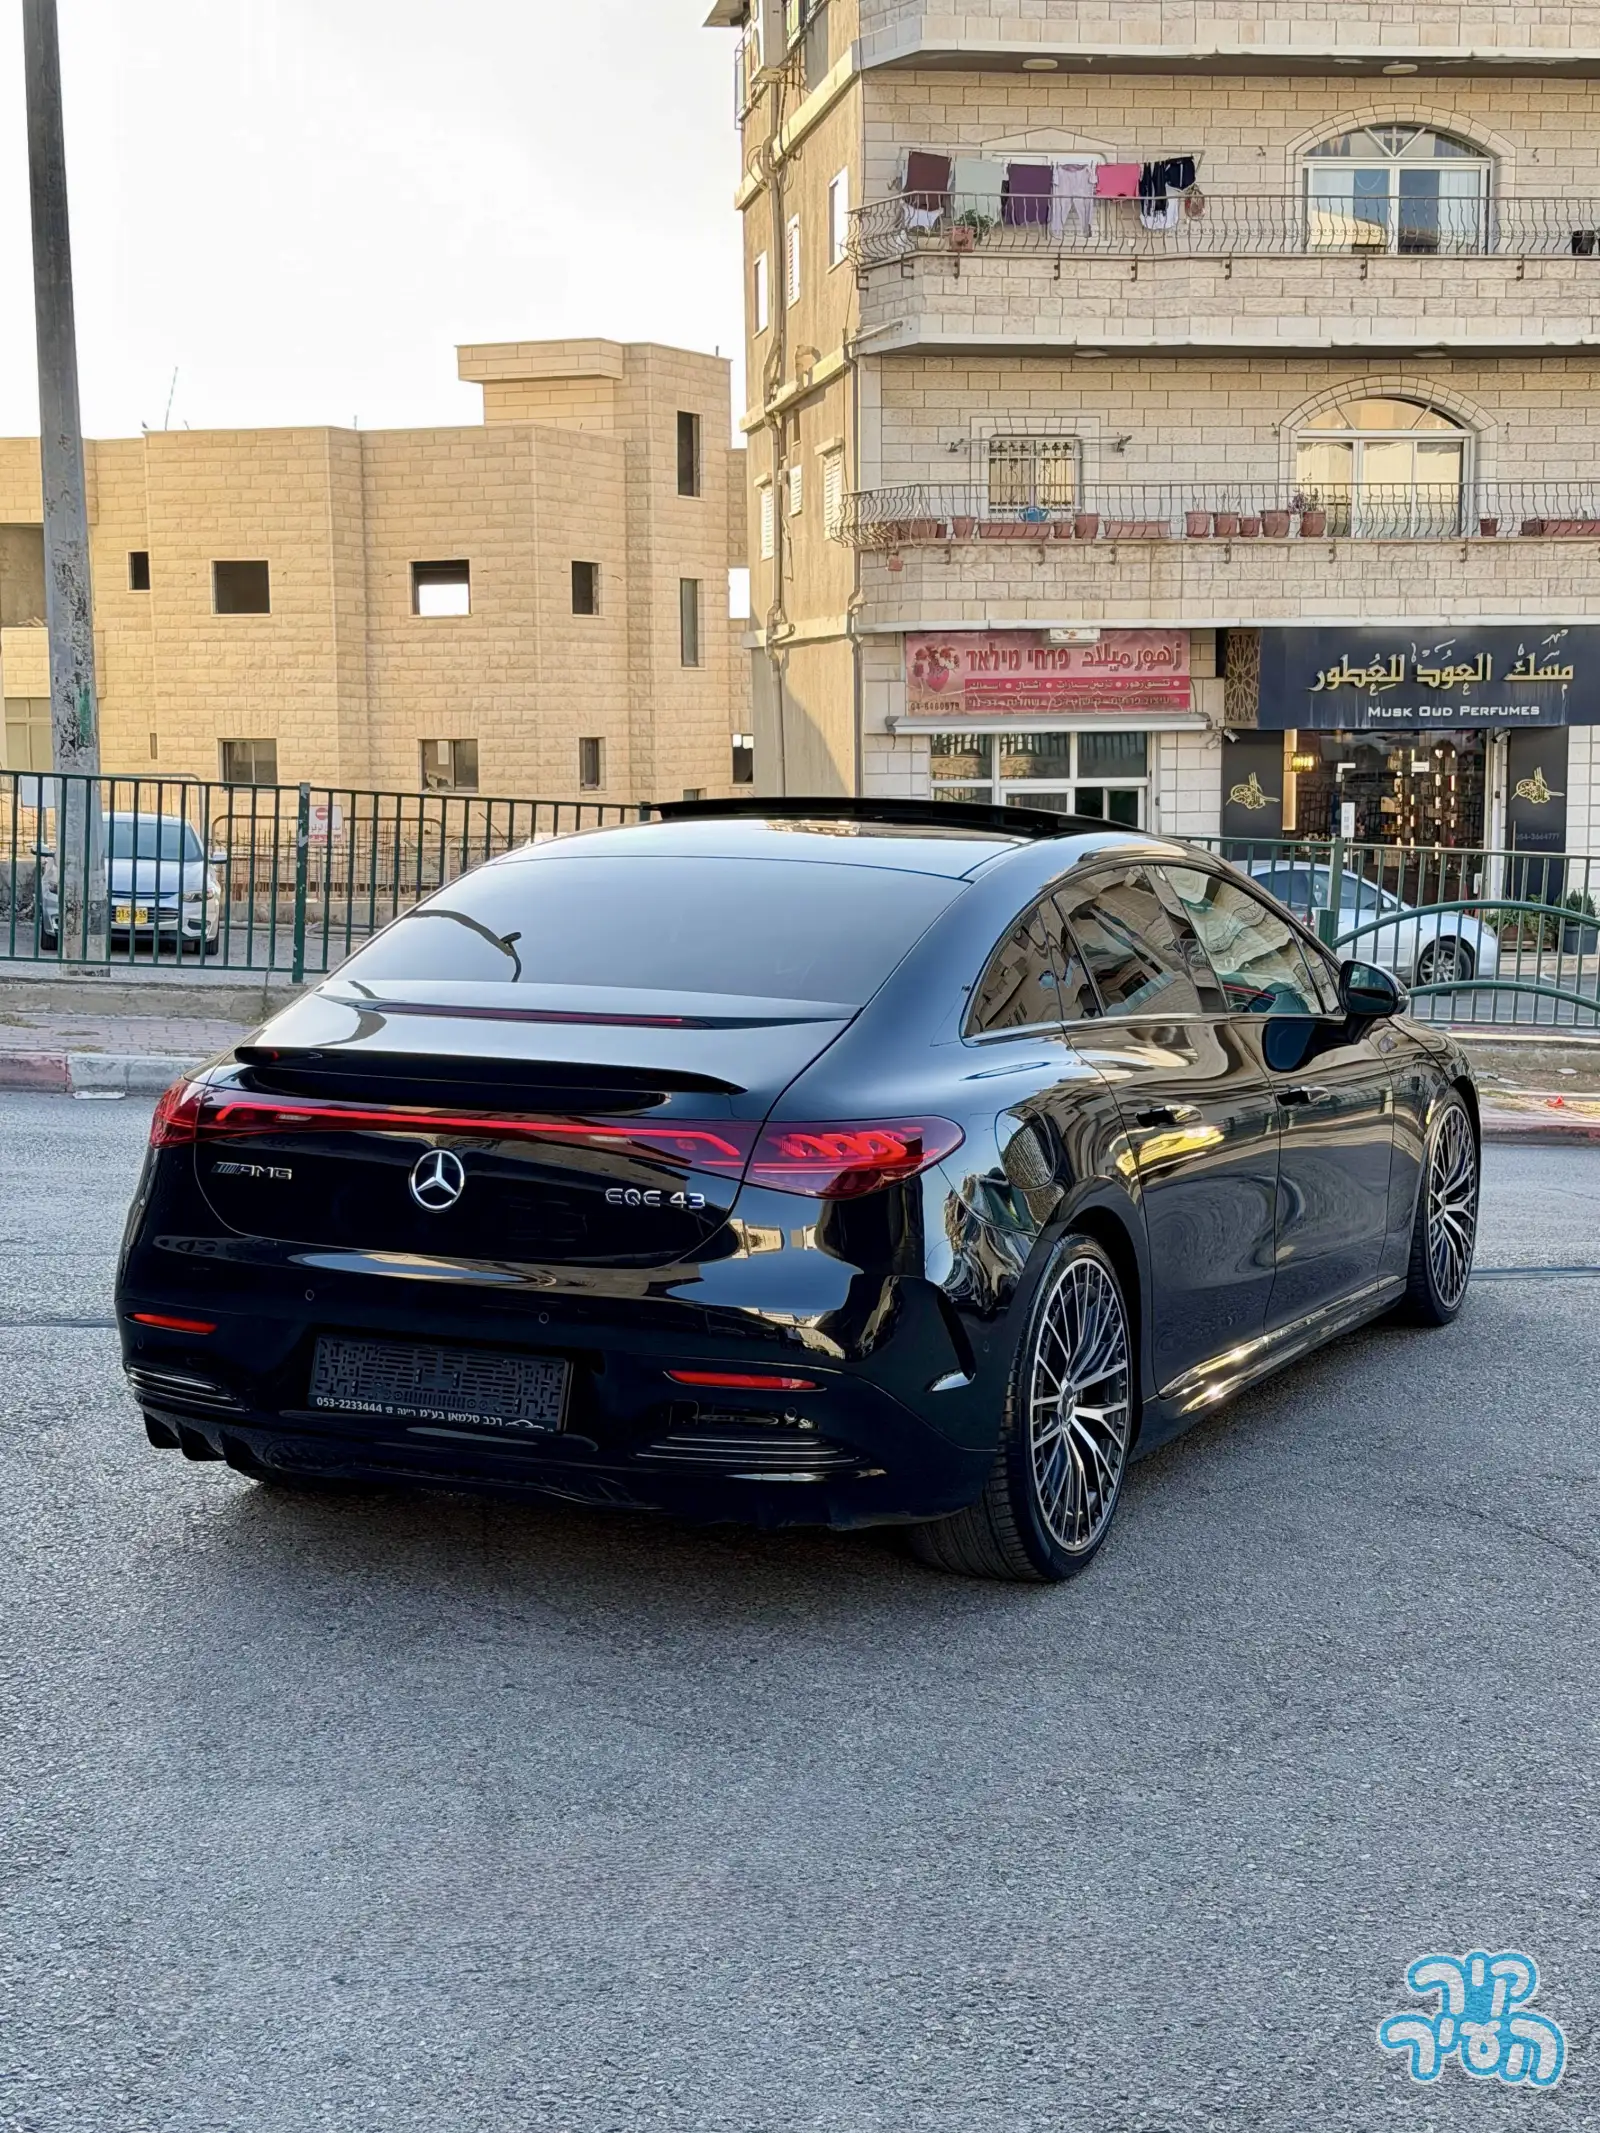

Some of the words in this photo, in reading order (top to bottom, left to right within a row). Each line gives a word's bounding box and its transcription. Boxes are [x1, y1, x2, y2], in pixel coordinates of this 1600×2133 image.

[965, 642, 1021, 671] מילאד
[1028, 648, 1071, 670] פרחי
[1082, 642, 1134, 672] ميلاد
[1134, 642, 1183, 671] زهور
[1368, 706, 1413, 718] MUSK
[1418, 706, 1453, 718] OUD
[1459, 705, 1541, 717] PERFUMES
[240, 1163, 293, 1180] AMG
[604, 1187, 662, 1207] EQE
[669, 1191, 706, 1210] 43
[316, 1396, 382, 1413] 053-2233444
[419, 1408, 445, 1420] בע"מ
[448, 1411, 480, 1424] סלמאן
[482, 1415, 503, 1426] רכב
